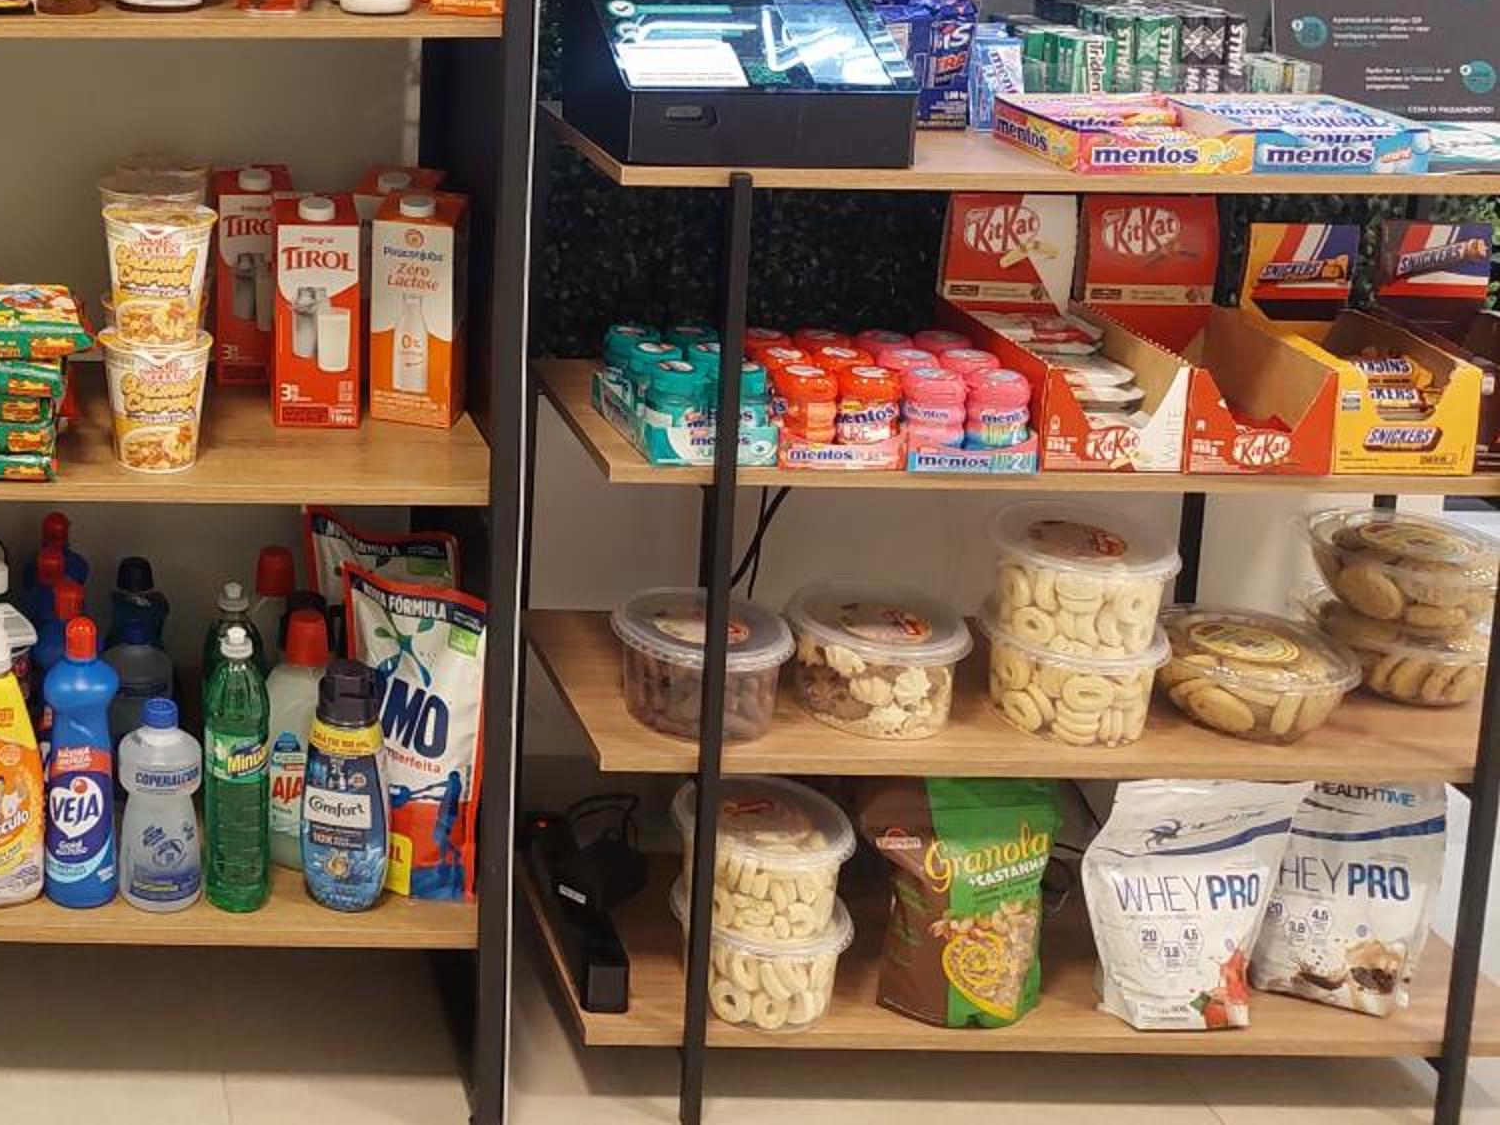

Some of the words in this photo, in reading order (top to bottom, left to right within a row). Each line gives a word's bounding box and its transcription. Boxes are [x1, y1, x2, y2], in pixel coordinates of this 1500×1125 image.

[995, 114, 1048, 152] mentos
[1092, 146, 1200, 165] mentos
[1266, 146, 1374, 165] mentos
[973, 204, 1041, 251] KitKat
[1110, 205, 1181, 256] KitKat
[282, 246, 356, 272] TIROL
[397, 262, 431, 277] Zero
[1260, 259, 1321, 280] SNICKERS
[1398, 244, 1465, 275] SNICKERS
[387, 277, 440, 292] Lactose
[1086, 427, 1141, 460] KitKat
[1235, 432, 1290, 462] KitKat
[1366, 428, 1435, 446] SNICKERS
[790, 449, 854, 462] mentos
[917, 455, 990, 467] mentos
[380, 680, 449, 759] MO
[272, 773, 315, 803] AJA
[51, 795, 102, 823] VEJA
[307, 795, 366, 818] Comfort
[922, 823, 1051, 893] Granola
[1278, 855, 1340, 894] HEY
[1347, 862, 1411, 900] PRO
[1113, 874, 1201, 912] WHEY
[1206, 873, 1260, 911] PRO
